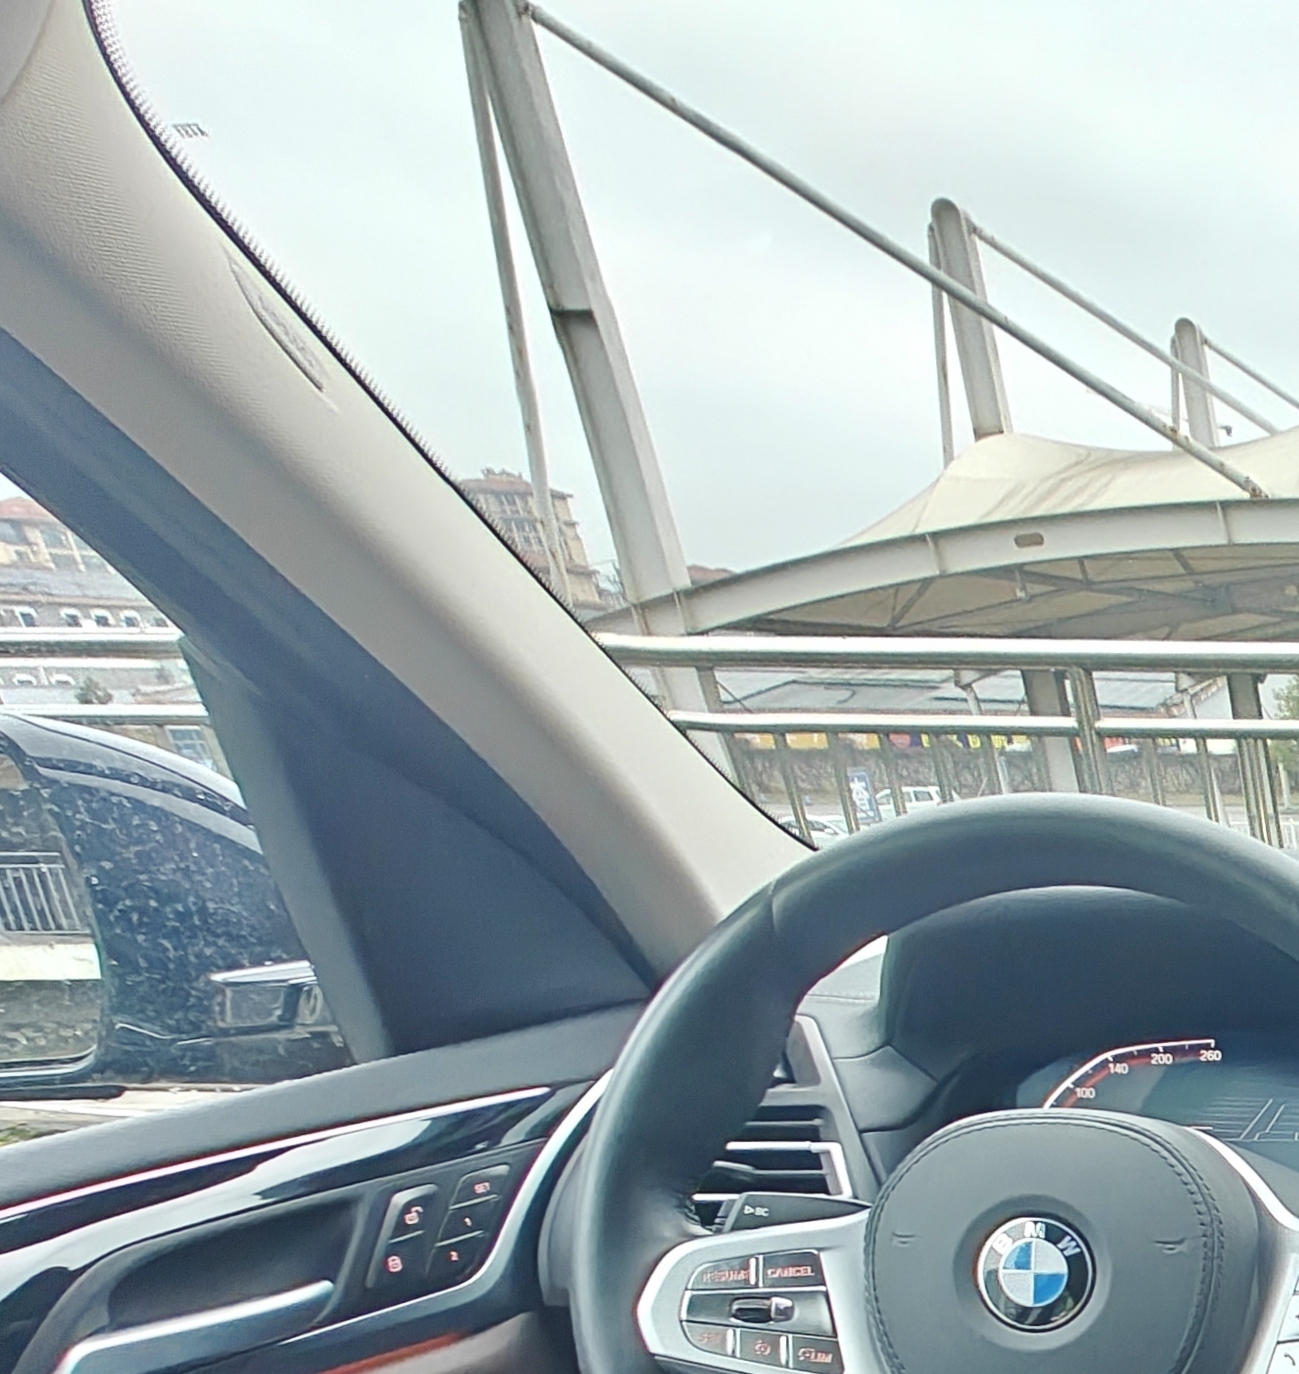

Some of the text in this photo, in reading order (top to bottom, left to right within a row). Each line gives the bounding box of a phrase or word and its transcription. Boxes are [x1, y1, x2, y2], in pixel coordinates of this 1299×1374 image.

[1151, 1053, 1173, 1065] 200
[1200, 1050, 1222, 1061] 260
[1108, 1063, 1129, 1074] 140
[1075, 1087, 1096, 1099] 100
[474, 1182, 490, 1193] SET
[992, 1221, 1081, 1257] BMW
[450, 1251, 459, 1261] 2
